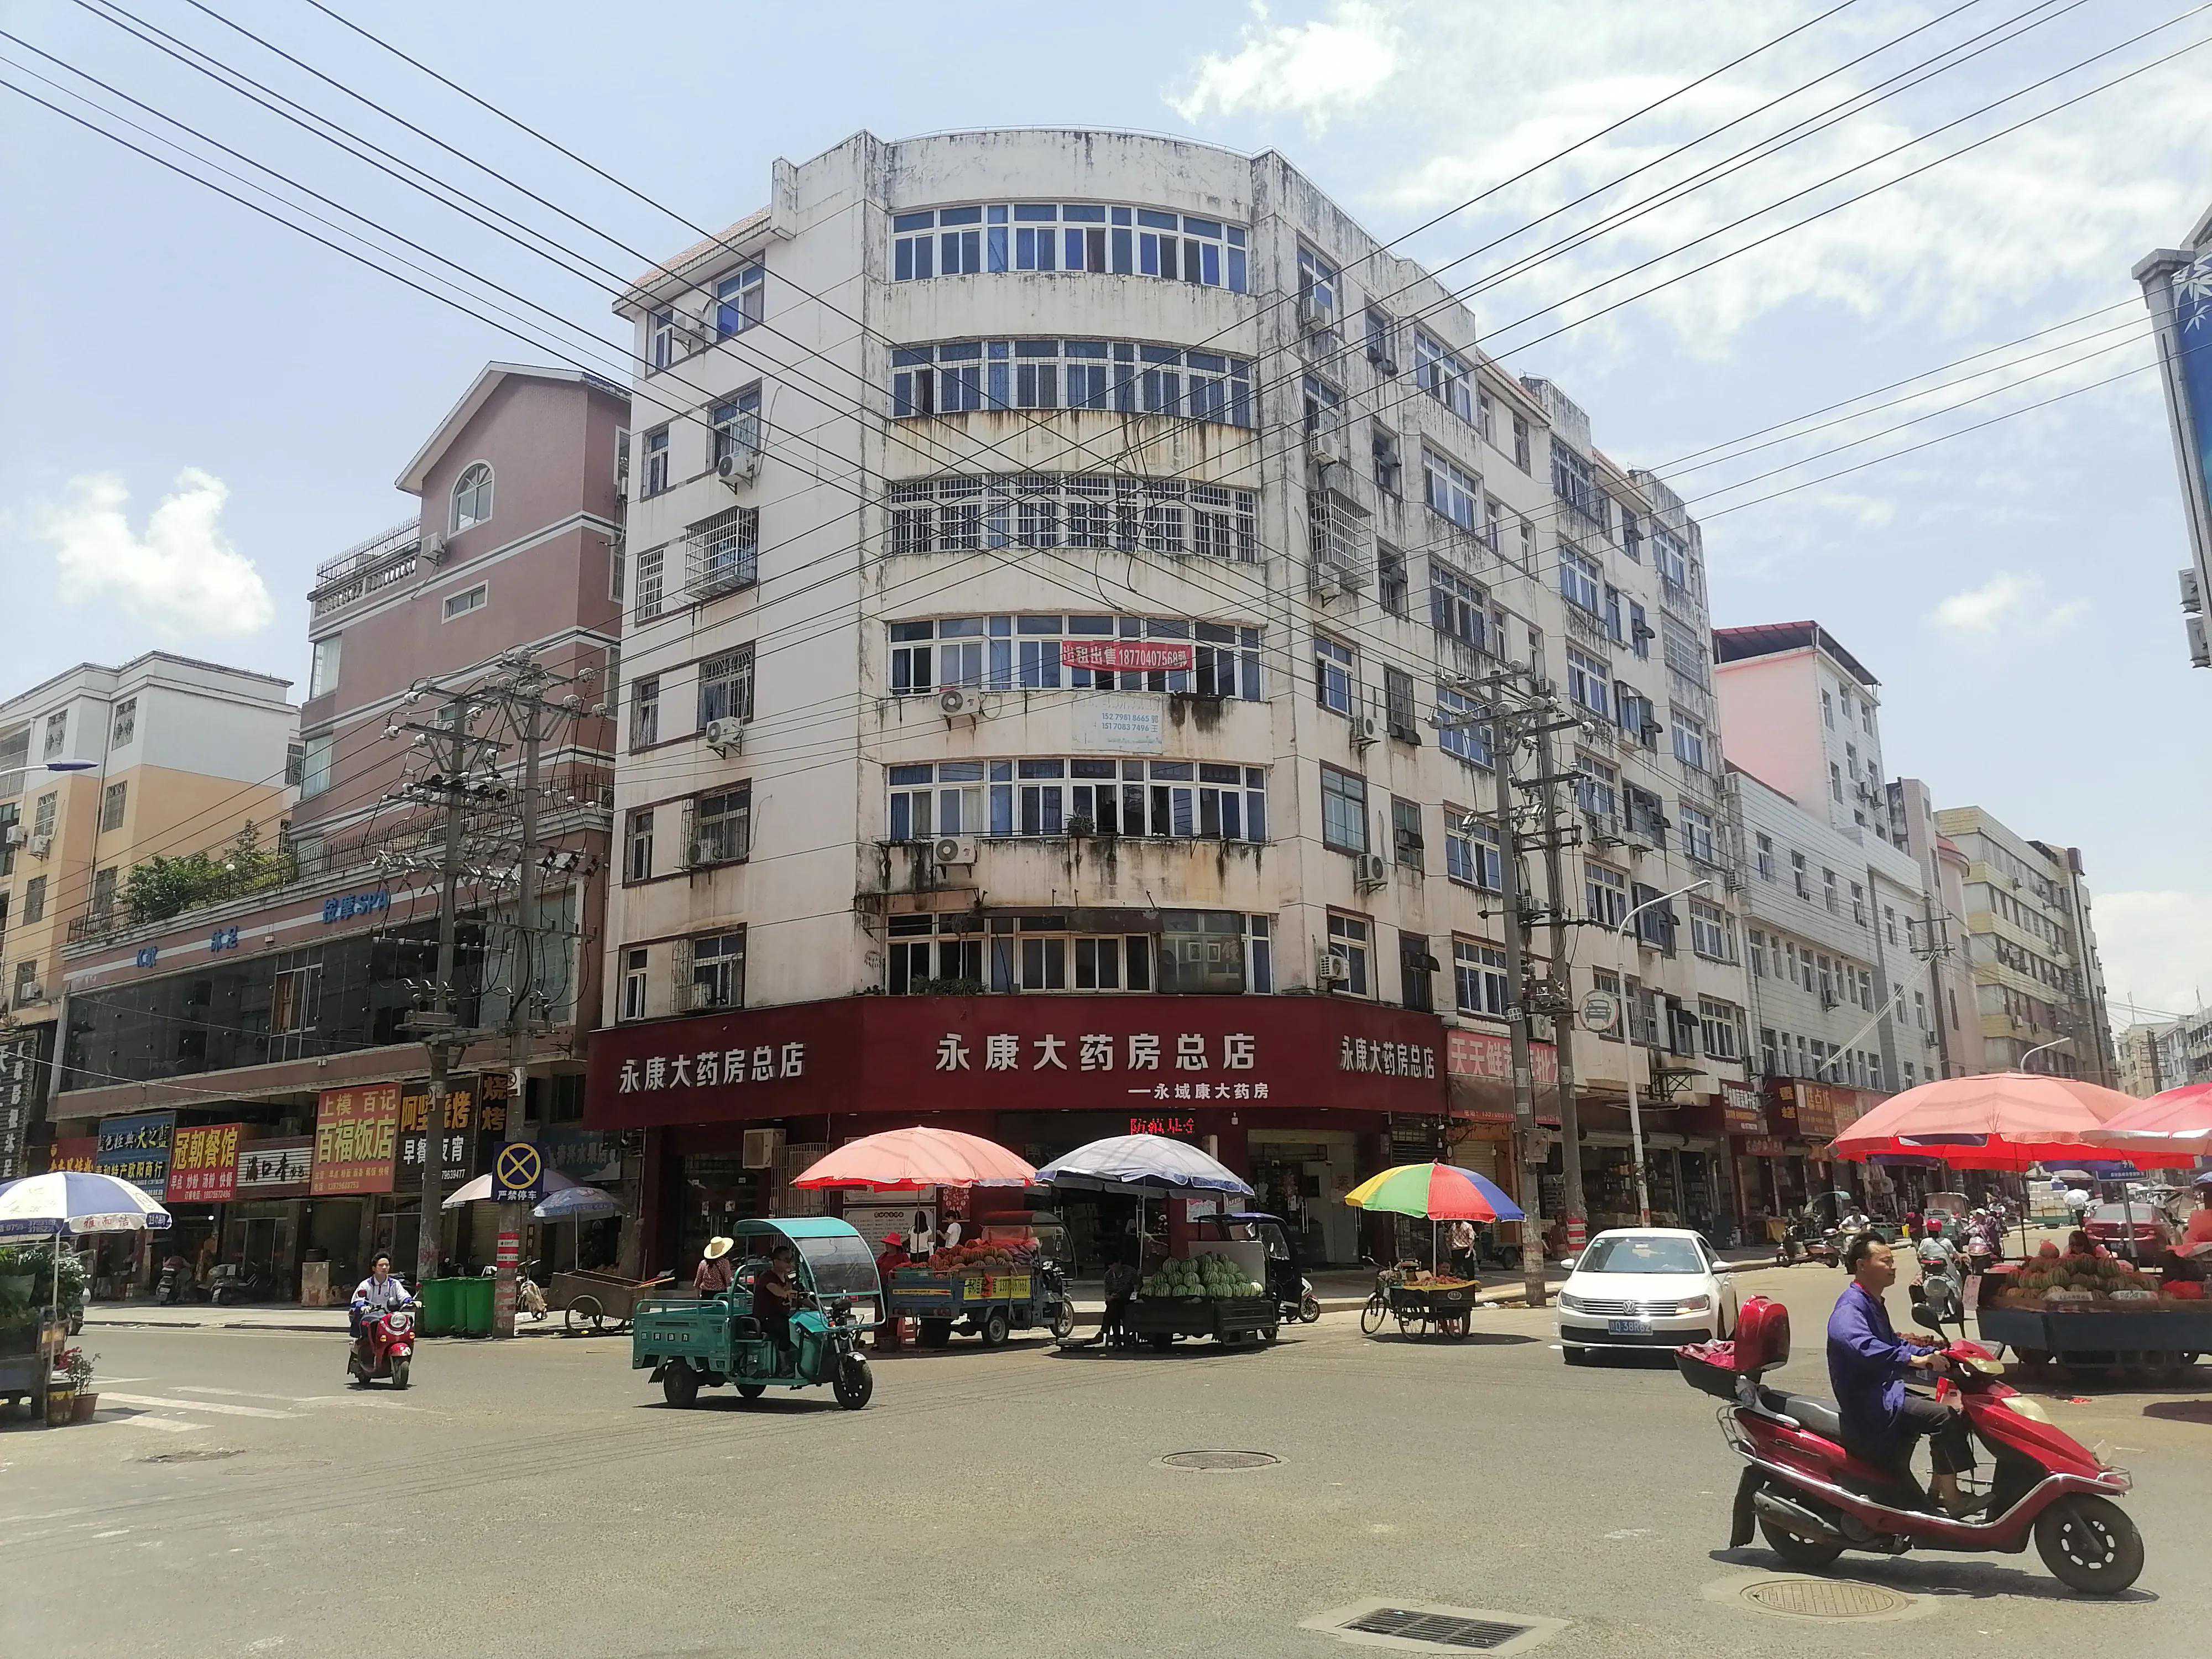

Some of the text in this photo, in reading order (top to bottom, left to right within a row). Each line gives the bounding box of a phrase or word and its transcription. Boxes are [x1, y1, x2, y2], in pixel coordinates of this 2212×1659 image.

[619, 1042, 805, 1093] 永康大药房总店
[936, 1033, 1255, 1071] 永康大药房总店
[1340, 1035, 1434, 1079] 永康大药房总店
[320, 1089, 396, 1117] 上模 百记
[173, 1127, 238, 1170] 冠朝餐馆
[318, 1114, 396, 1164] 百福饭店
[220, 1172, 232, 1187] 快餐
[497, 1190, 537, 1201] 严禁停车
